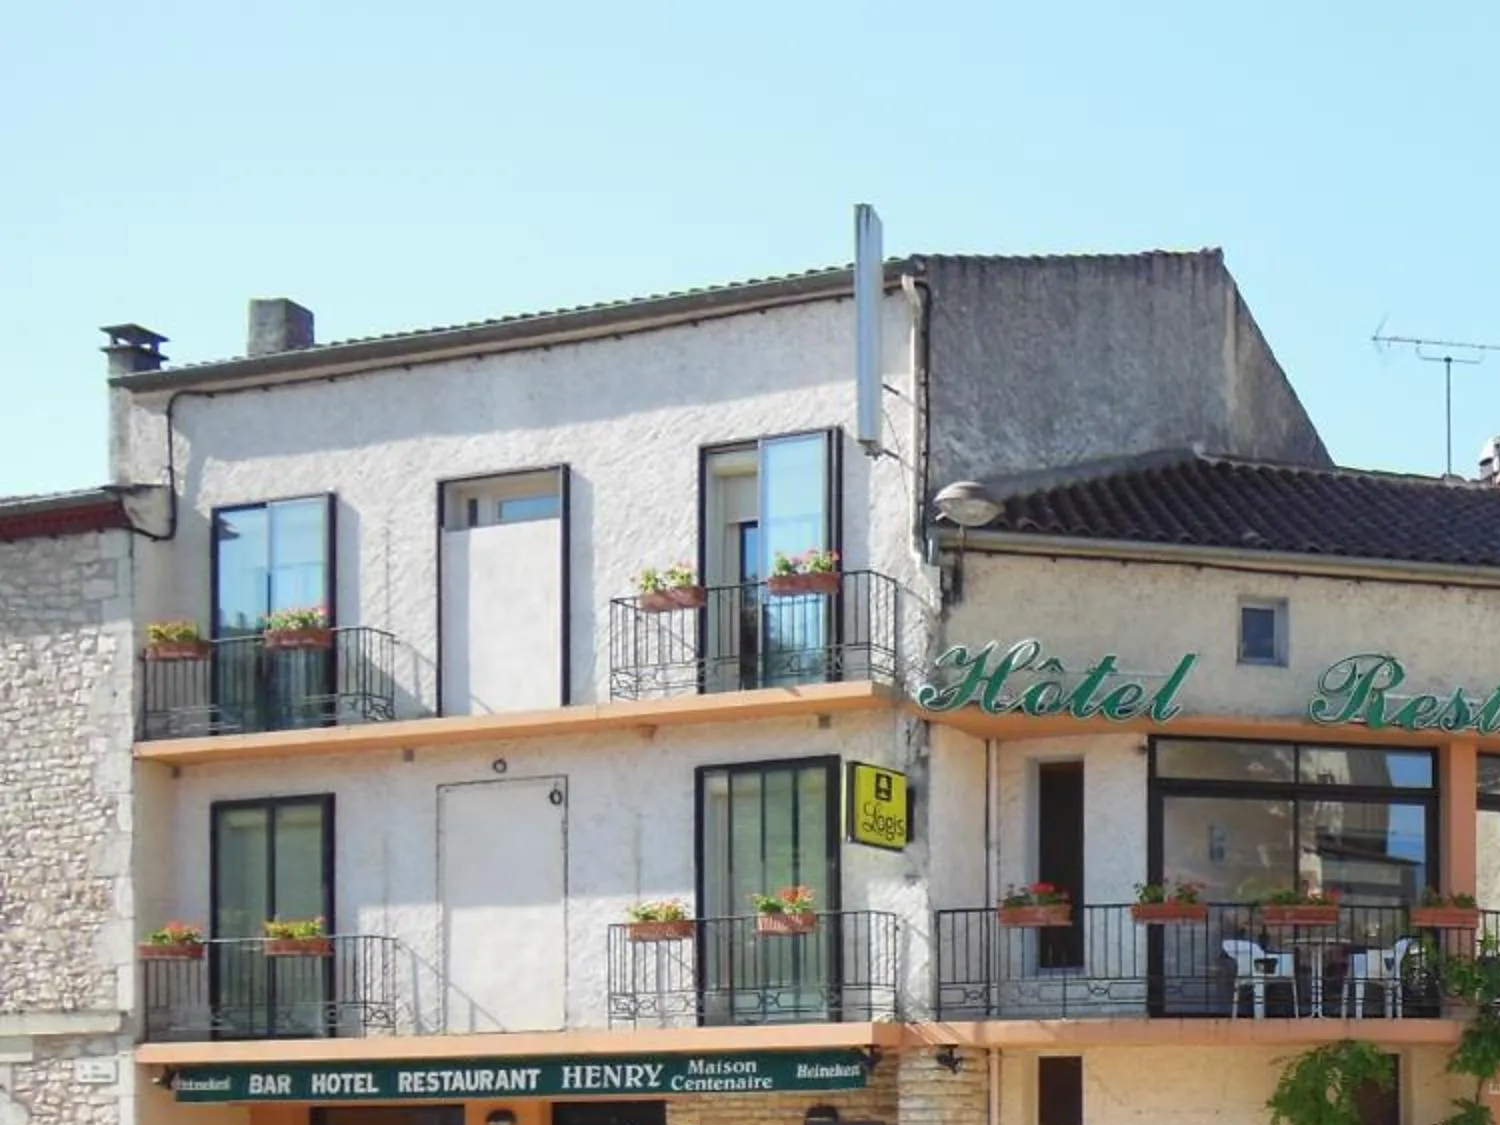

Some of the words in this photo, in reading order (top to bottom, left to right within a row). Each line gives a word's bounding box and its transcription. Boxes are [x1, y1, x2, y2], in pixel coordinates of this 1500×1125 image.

[918, 637, 1197, 721] Hôtel
[861, 802, 905, 841] Logis
[249, 1074, 291, 1094] BAR
[312, 1073, 379, 1094] HOTEL
[399, 1069, 541, 1093] RESTAURANT
[561, 1064, 664, 1089] HENRY
[687, 1059, 757, 1075] Maison
[797, 1063, 861, 1079] Heineken
[671, 1074, 774, 1092] Centenaire
